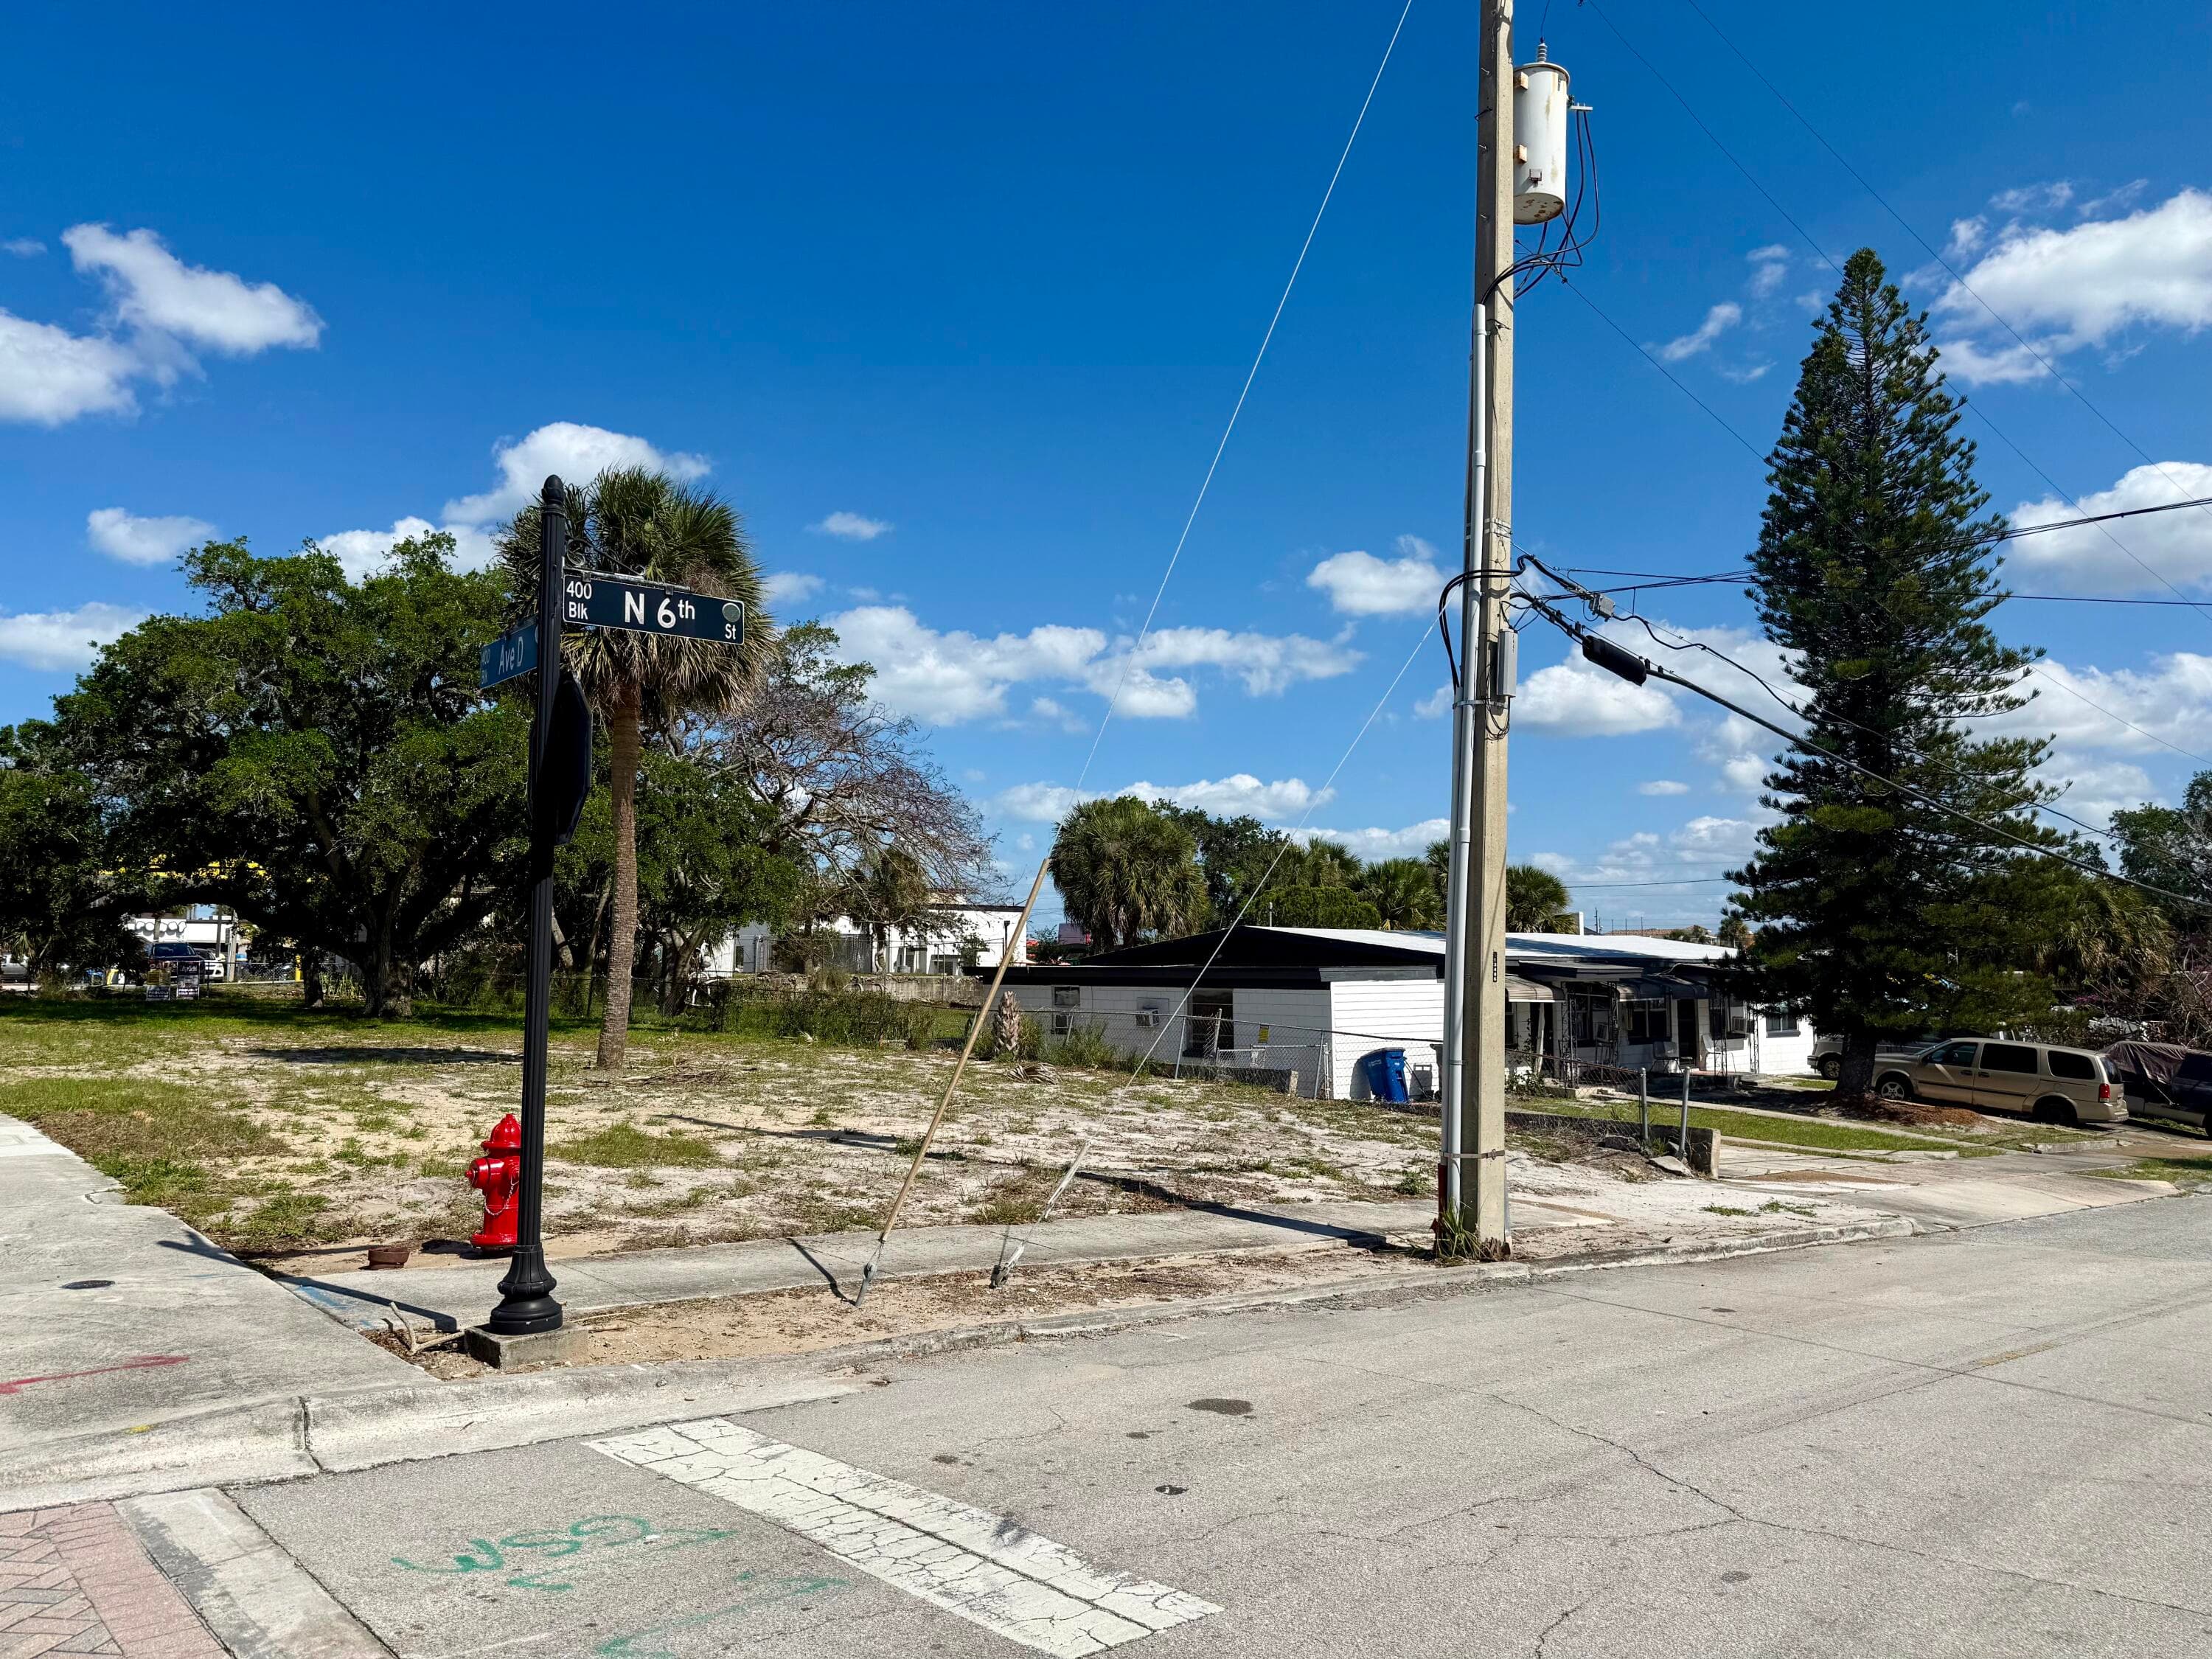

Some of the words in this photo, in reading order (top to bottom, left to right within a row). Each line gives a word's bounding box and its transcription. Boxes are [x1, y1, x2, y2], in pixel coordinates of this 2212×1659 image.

[566, 580, 592, 599] 400
[568, 601, 588, 620] Blk
[625, 591, 644, 625] N
[657, 597, 695, 629] 6th
[725, 623, 737, 640] St
[498, 644, 515, 675] Ave
[517, 636, 524, 667] D
